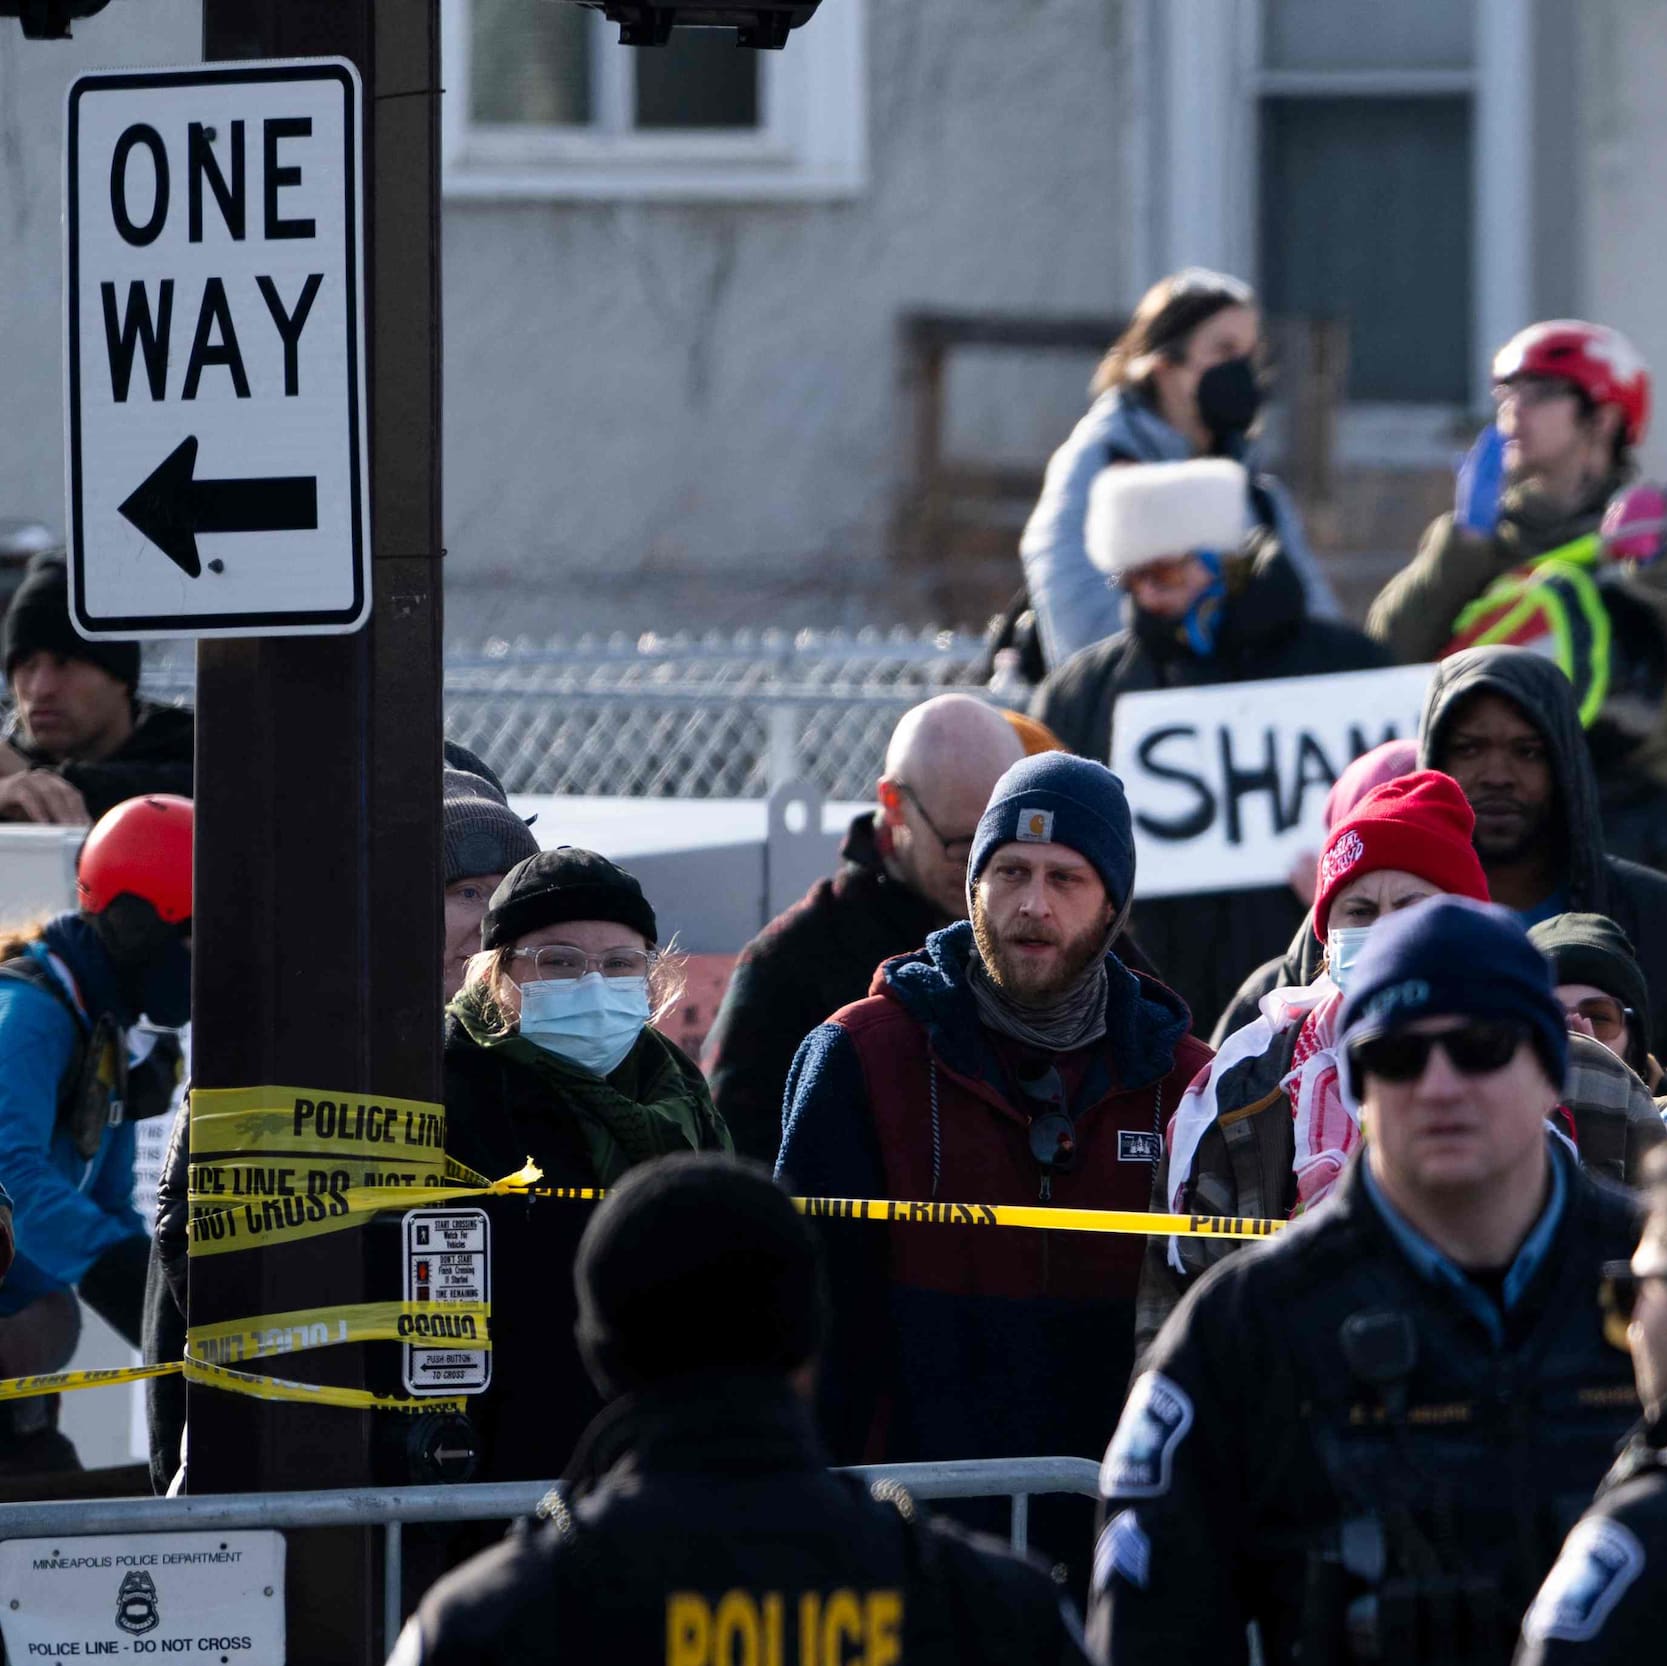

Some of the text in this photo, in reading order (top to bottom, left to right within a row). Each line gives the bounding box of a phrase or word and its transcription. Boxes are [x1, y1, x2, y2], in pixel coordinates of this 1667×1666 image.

[110, 116, 316, 247] ONE
[100, 273, 325, 403] WAY
[1136, 722, 1400, 845] SHA
[293, 1098, 445, 1149] POLICE LIN
[232, 1166, 295, 1196] LINE
[32, 1551, 242, 1571] MINNEAPOLIS POLICE DEPARTMENT
[28, 1642, 80, 1656] POLICE
[85, 1641, 119, 1655] LINE
[133, 1640, 157, 1653] DO
[162, 1639, 193, 1653] NOT
[197, 1636, 252, 1651] CROSS
